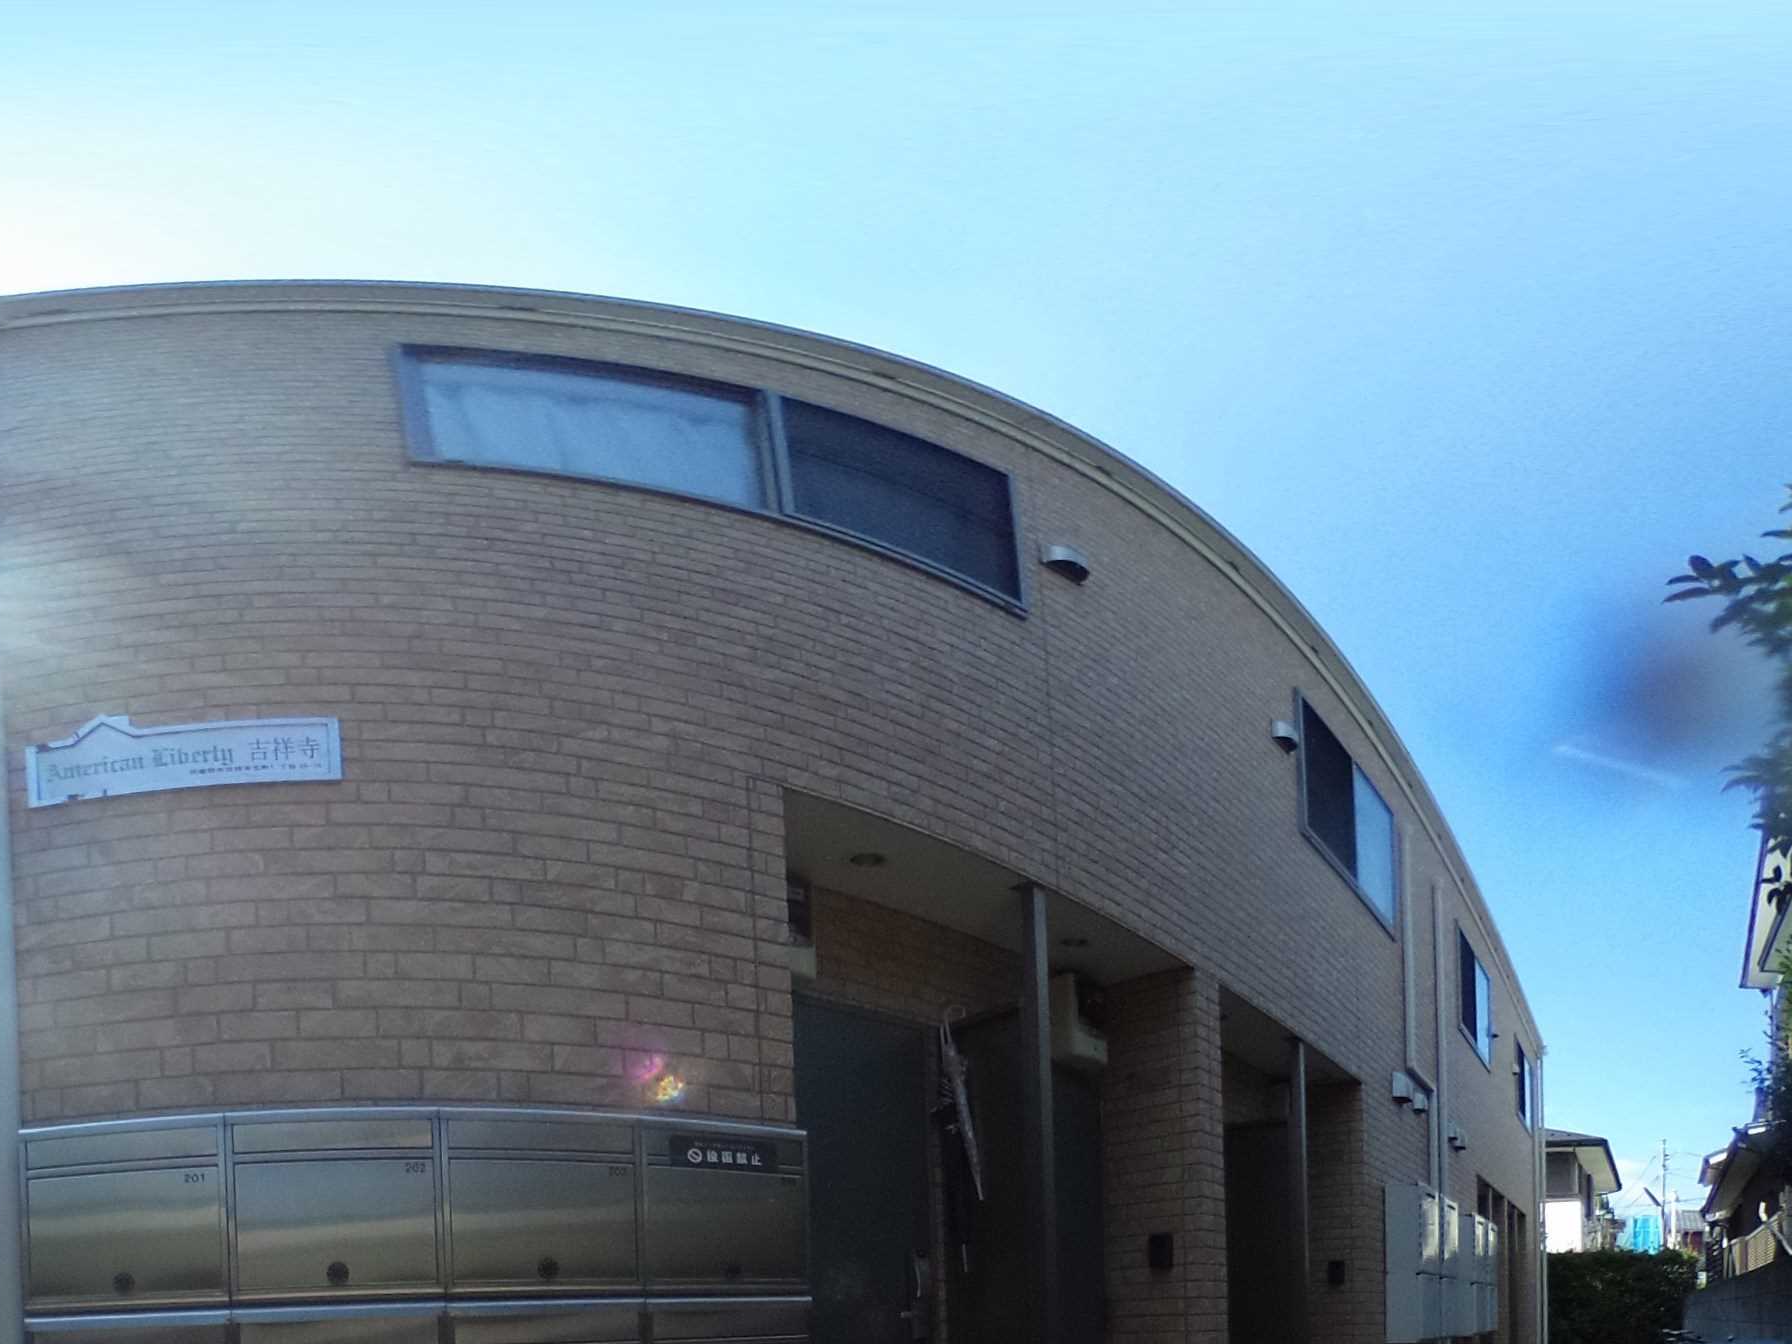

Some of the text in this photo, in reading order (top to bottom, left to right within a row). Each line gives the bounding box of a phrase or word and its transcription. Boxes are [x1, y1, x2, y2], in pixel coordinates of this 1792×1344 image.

[47, 736, 320, 783] American Liberty 吉祥寺
[405, 1162, 425, 1174] 202
[183, 1173, 205, 1184] 201
